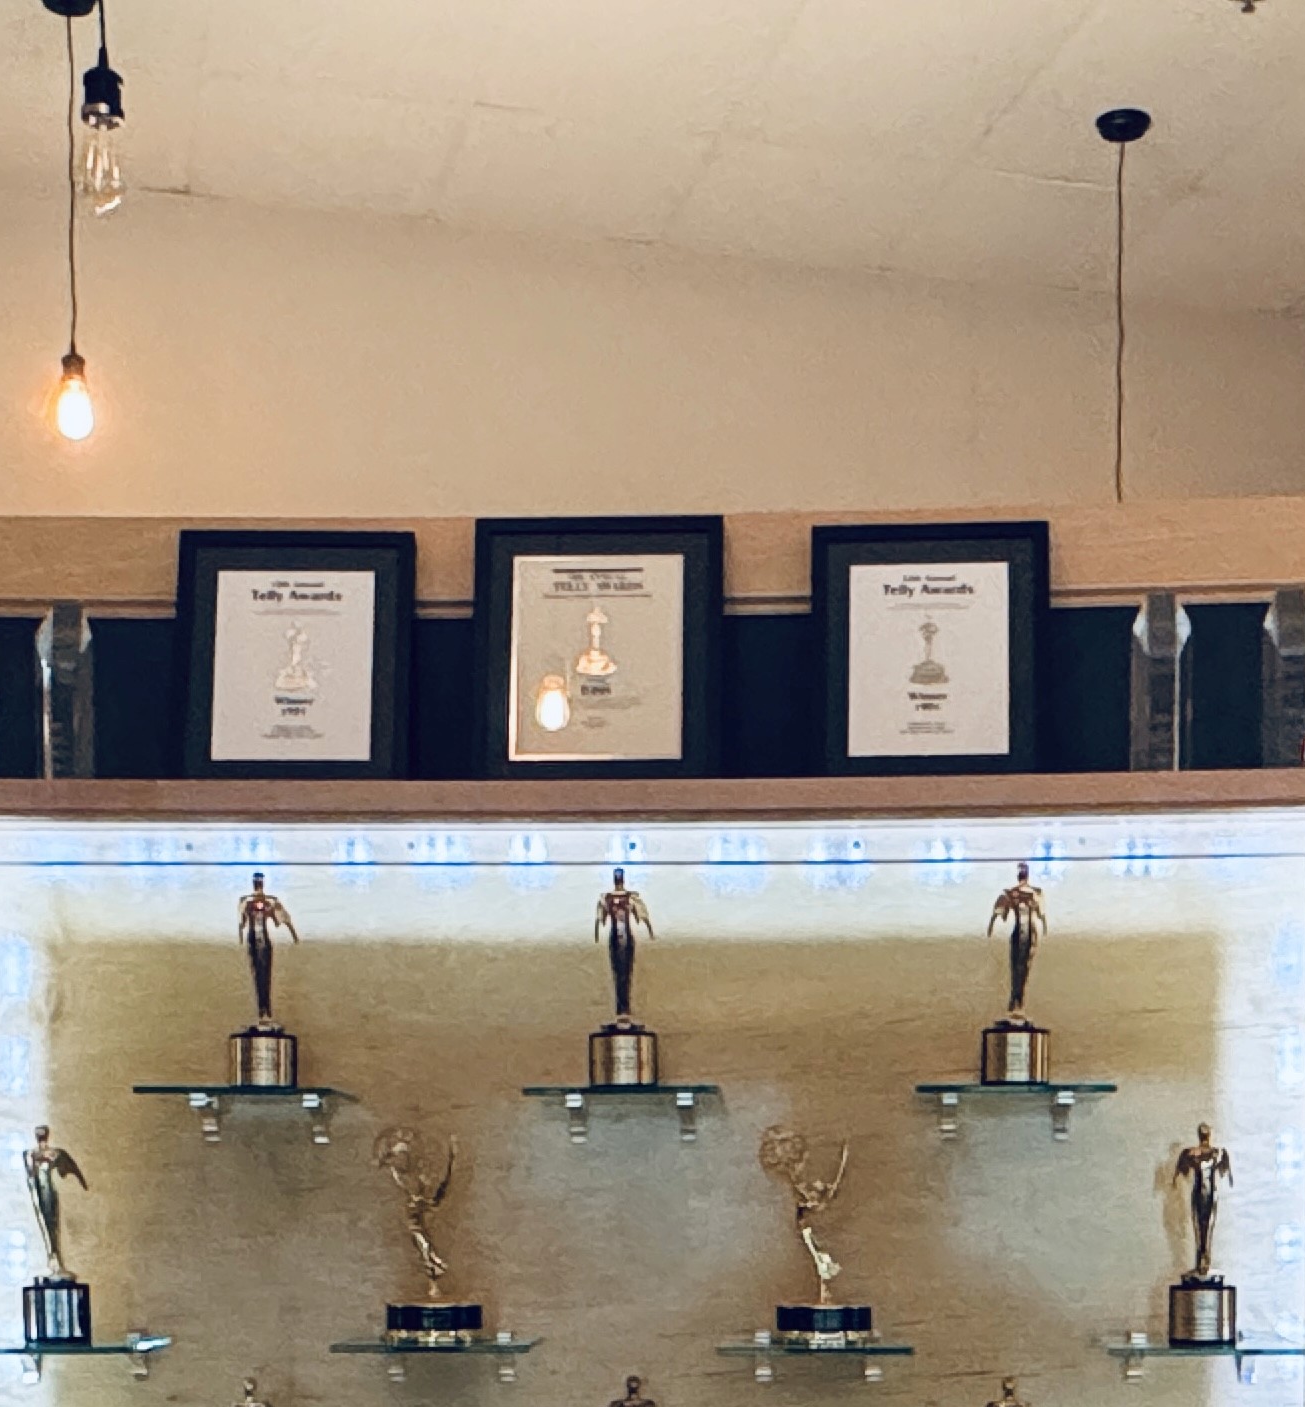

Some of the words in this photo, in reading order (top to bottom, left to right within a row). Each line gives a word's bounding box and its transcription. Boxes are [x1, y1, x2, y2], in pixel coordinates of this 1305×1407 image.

[251, 589, 283, 602] Telly
[289, 590, 343, 601] Awards
[883, 584, 915, 597] Telly
[921, 583, 975, 594] Awards
